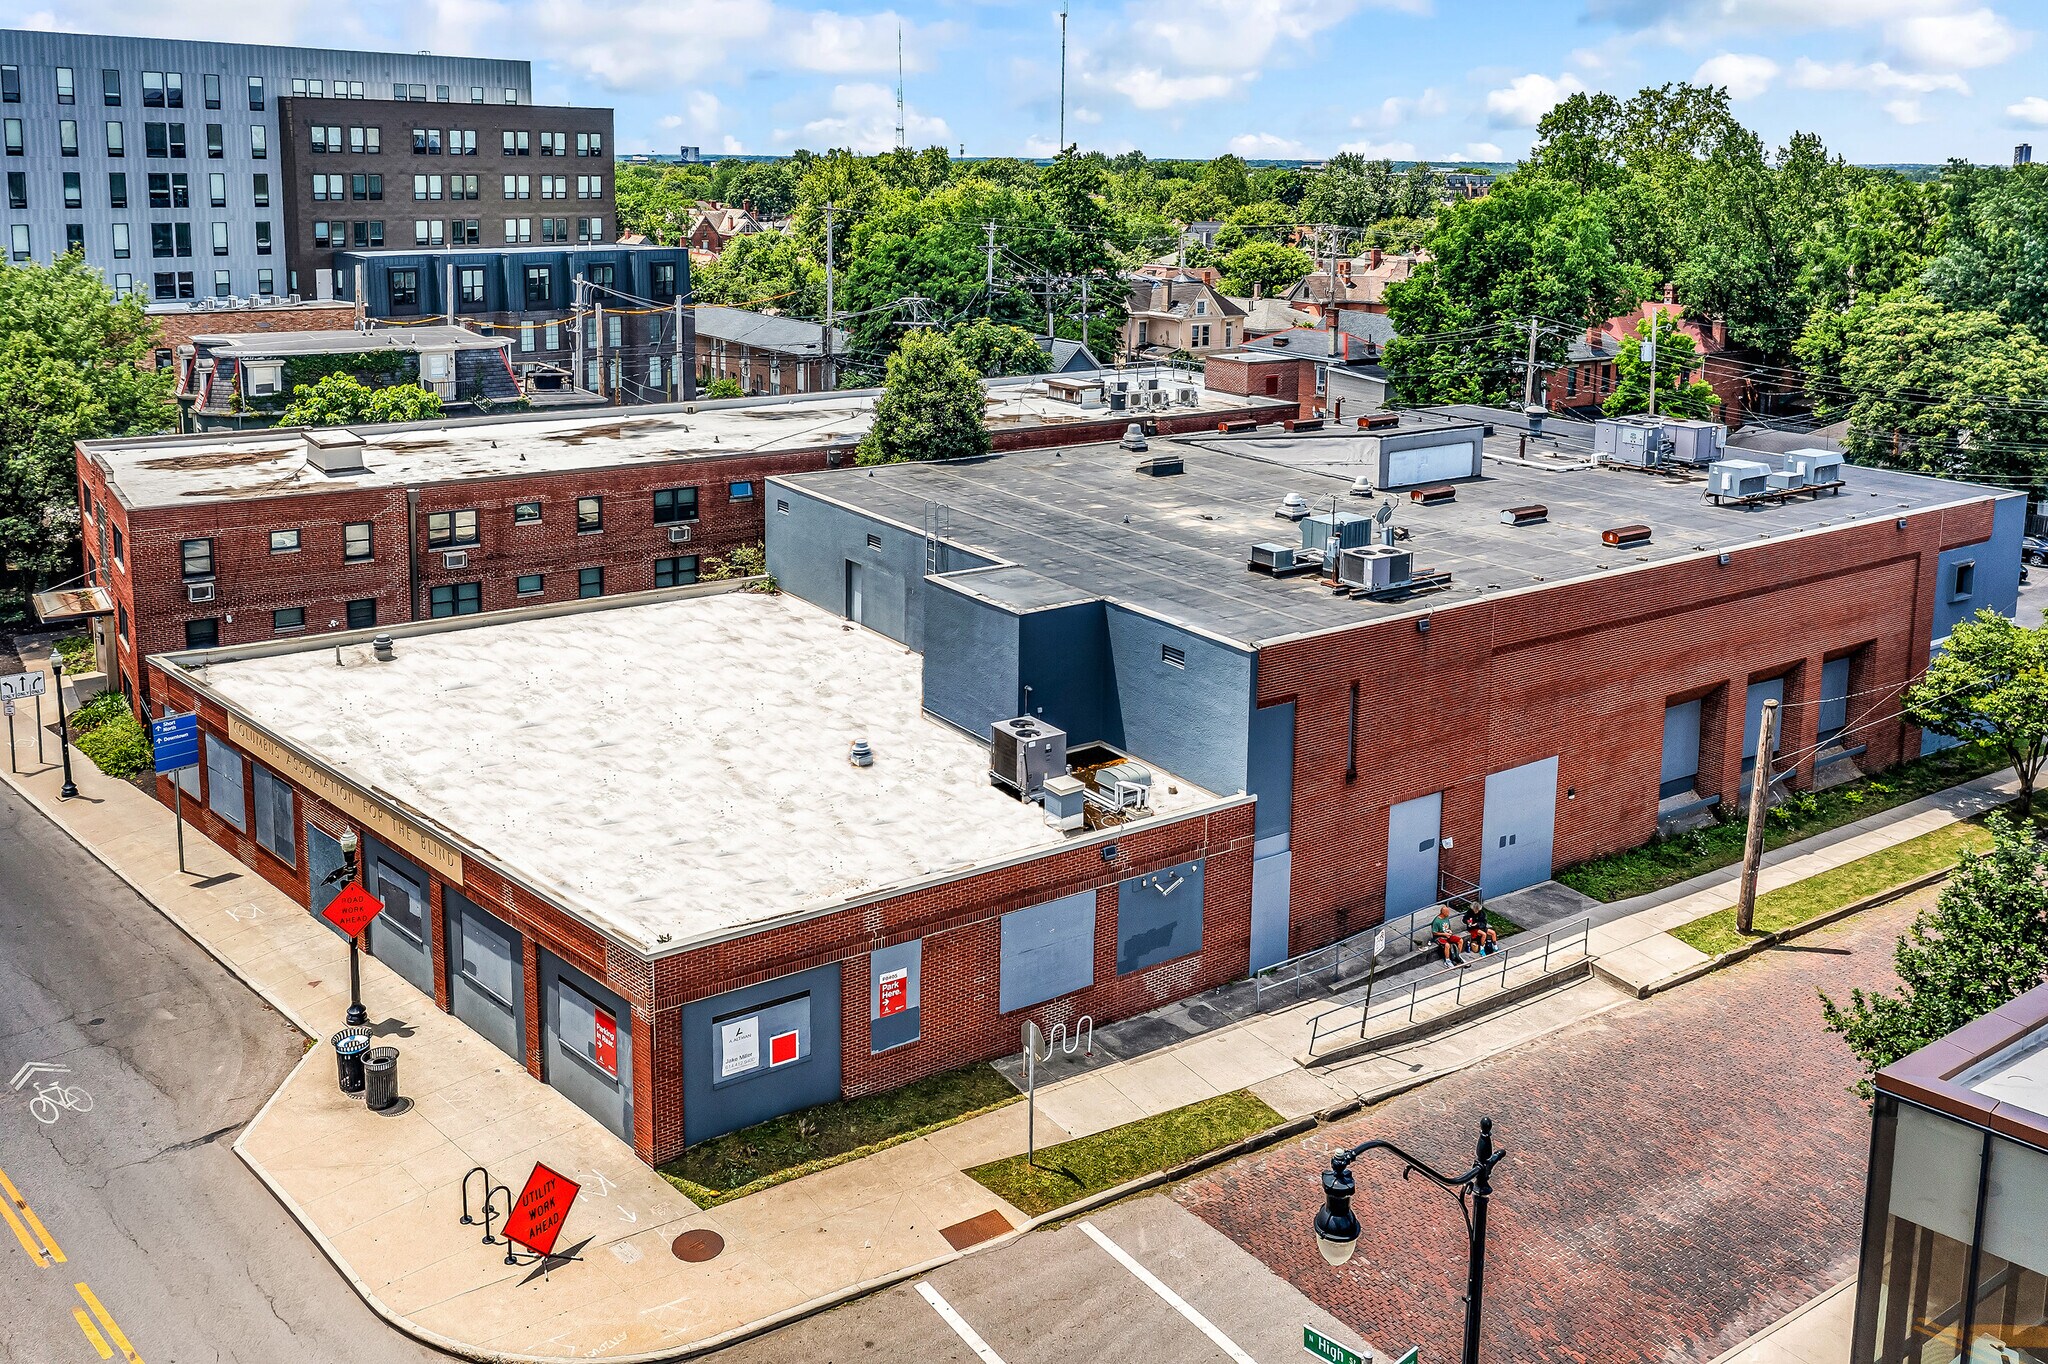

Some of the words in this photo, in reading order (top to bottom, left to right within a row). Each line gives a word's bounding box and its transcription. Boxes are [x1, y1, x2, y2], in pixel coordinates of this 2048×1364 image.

[163, 732, 189, 742] Downtown
[233, 721, 280, 759] COLUMBUS
[286, 754, 354, 804] ASSOCIATION
[363, 800, 383, 823] FOR
[391, 817, 412, 842] THE
[420, 835, 454, 867] BLIND
[341, 895, 364, 904] ROAD
[342, 905, 364, 914] WORK
[340, 915, 368, 924] AHEAD
[882, 981, 899, 991] Park
[882, 989, 902, 999] Here.
[596, 1022, 615, 1041] Parking
[601, 1034, 614, 1048] Rear.
[725, 1056, 738, 1064] Jake
[739, 1052, 753, 1060] Miller
[522, 1178, 556, 1207] UTILITY
[528, 1196, 556, 1221] WORK
[529, 1212, 560, 1239] AHEAD
[1308, 1334, 1314, 1343] N
[1318, 1336, 1344, 1362] High
[1348, 1356, 1357, 1364] St
